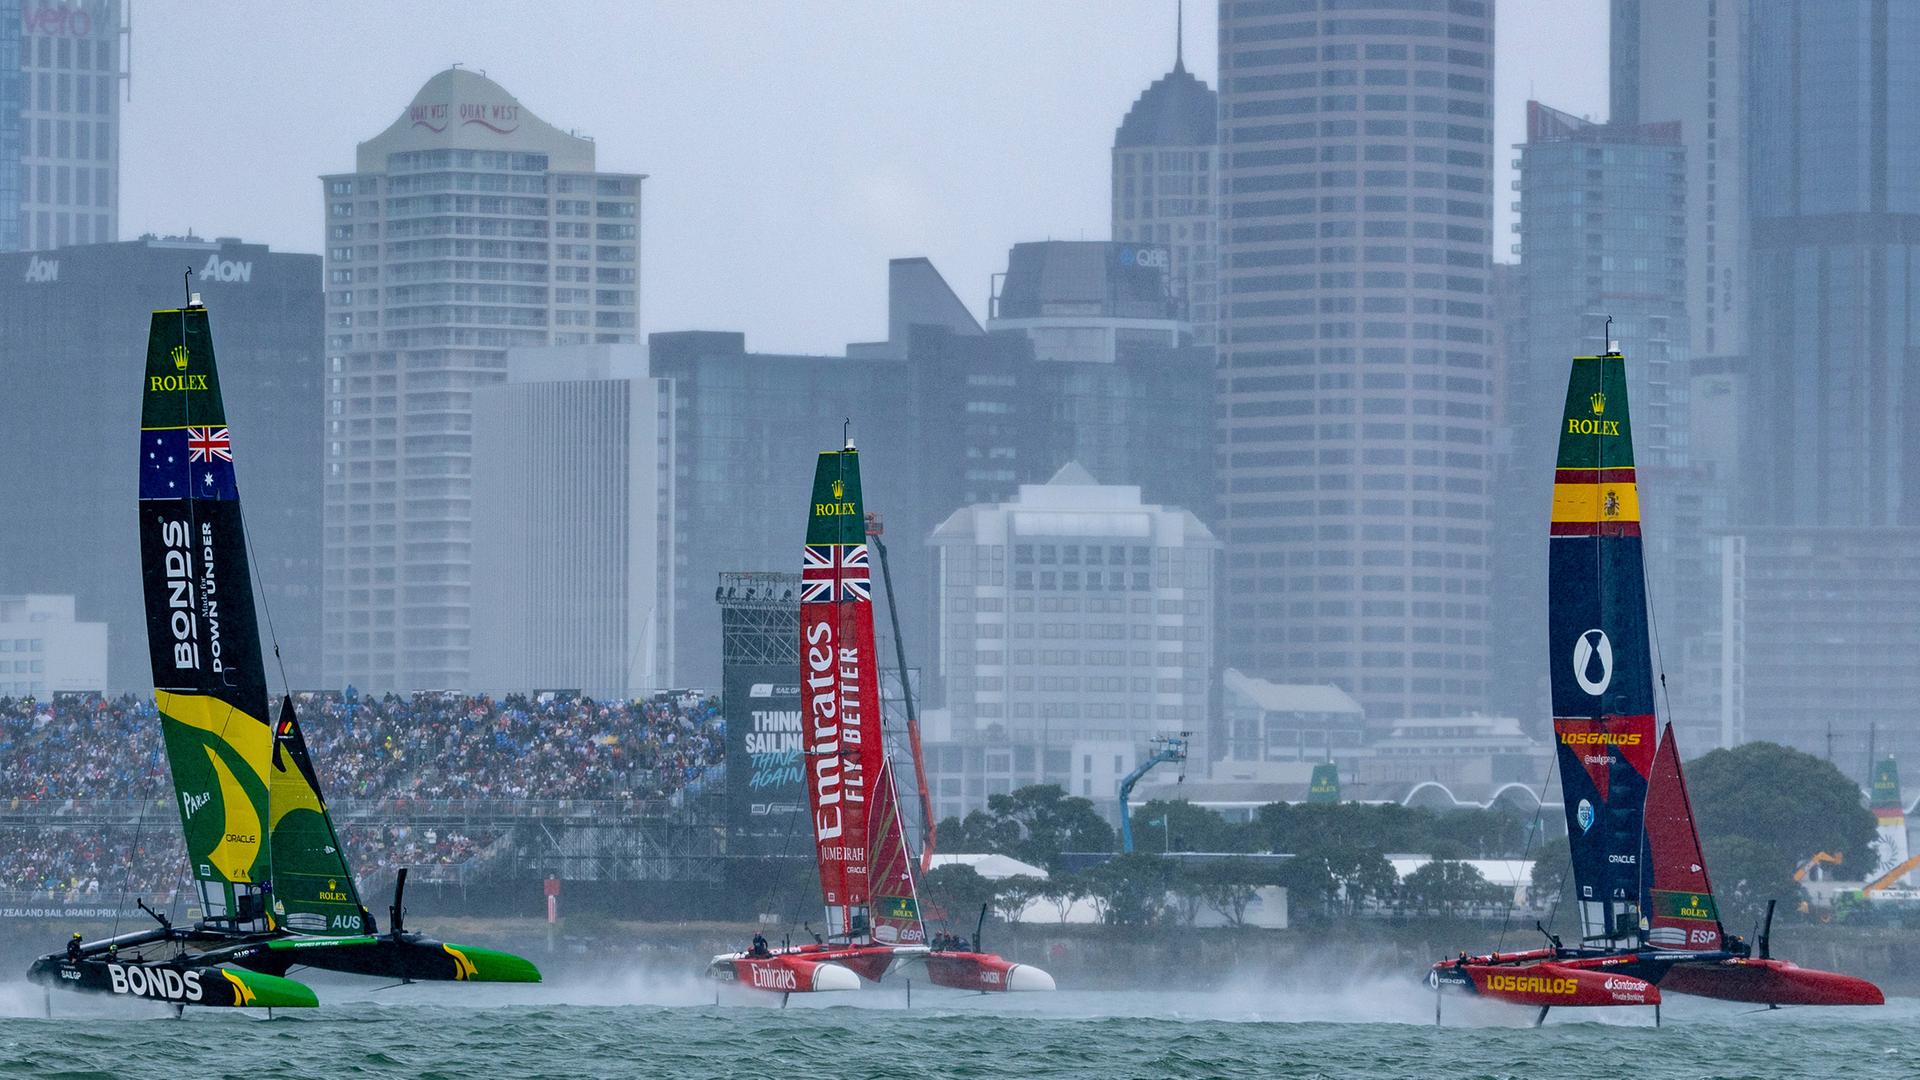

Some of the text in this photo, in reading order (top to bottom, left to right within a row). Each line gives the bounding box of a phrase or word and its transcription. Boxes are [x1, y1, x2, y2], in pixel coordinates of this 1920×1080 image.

[21, 6, 92, 37] vero
[410, 103, 448, 120] QUAY WEST
[460, 103, 518, 120] QUAY WEST
[1136, 249, 1169, 267] QBE
[150, 374, 208, 391] ROLEX
[1568, 418, 1619, 436] ROLEX
[815, 502, 856, 516] ROLEX
[162, 520, 194, 669] BONDS
[202, 522, 223, 673] DOWN UNDER
[752, 711, 803, 731] THINK
[840, 647, 864, 802] FLY BETTER
[806, 621, 842, 843] Emirates
[750, 748, 803, 771] THINK
[749, 763, 806, 791] AGAIN
[1311, 785, 1337, 793] ROLEX
[226, 834, 256, 844] ORACLE
[1608, 855, 1636, 864] ORACLE
[847, 866, 867, 874] ORACLE
[319, 891, 347, 901] ROLEX
[3, 908, 43, 917] ZEALAND
[44, 908, 62, 917] SAIL
[65, 908, 96, 917] GRAND
[97, 908, 117, 917] PRIX
[892, 909, 913, 918] ROLEX
[1680, 908, 1708, 918] ROLEX
[332, 915, 361, 929] AUS
[901, 929, 922, 941] GBR
[1690, 930, 1717, 944] ESP
[108, 963, 203, 1001] BONDS
[751, 963, 797, 990] Emirates
[1613, 979, 1648, 991] Santander
